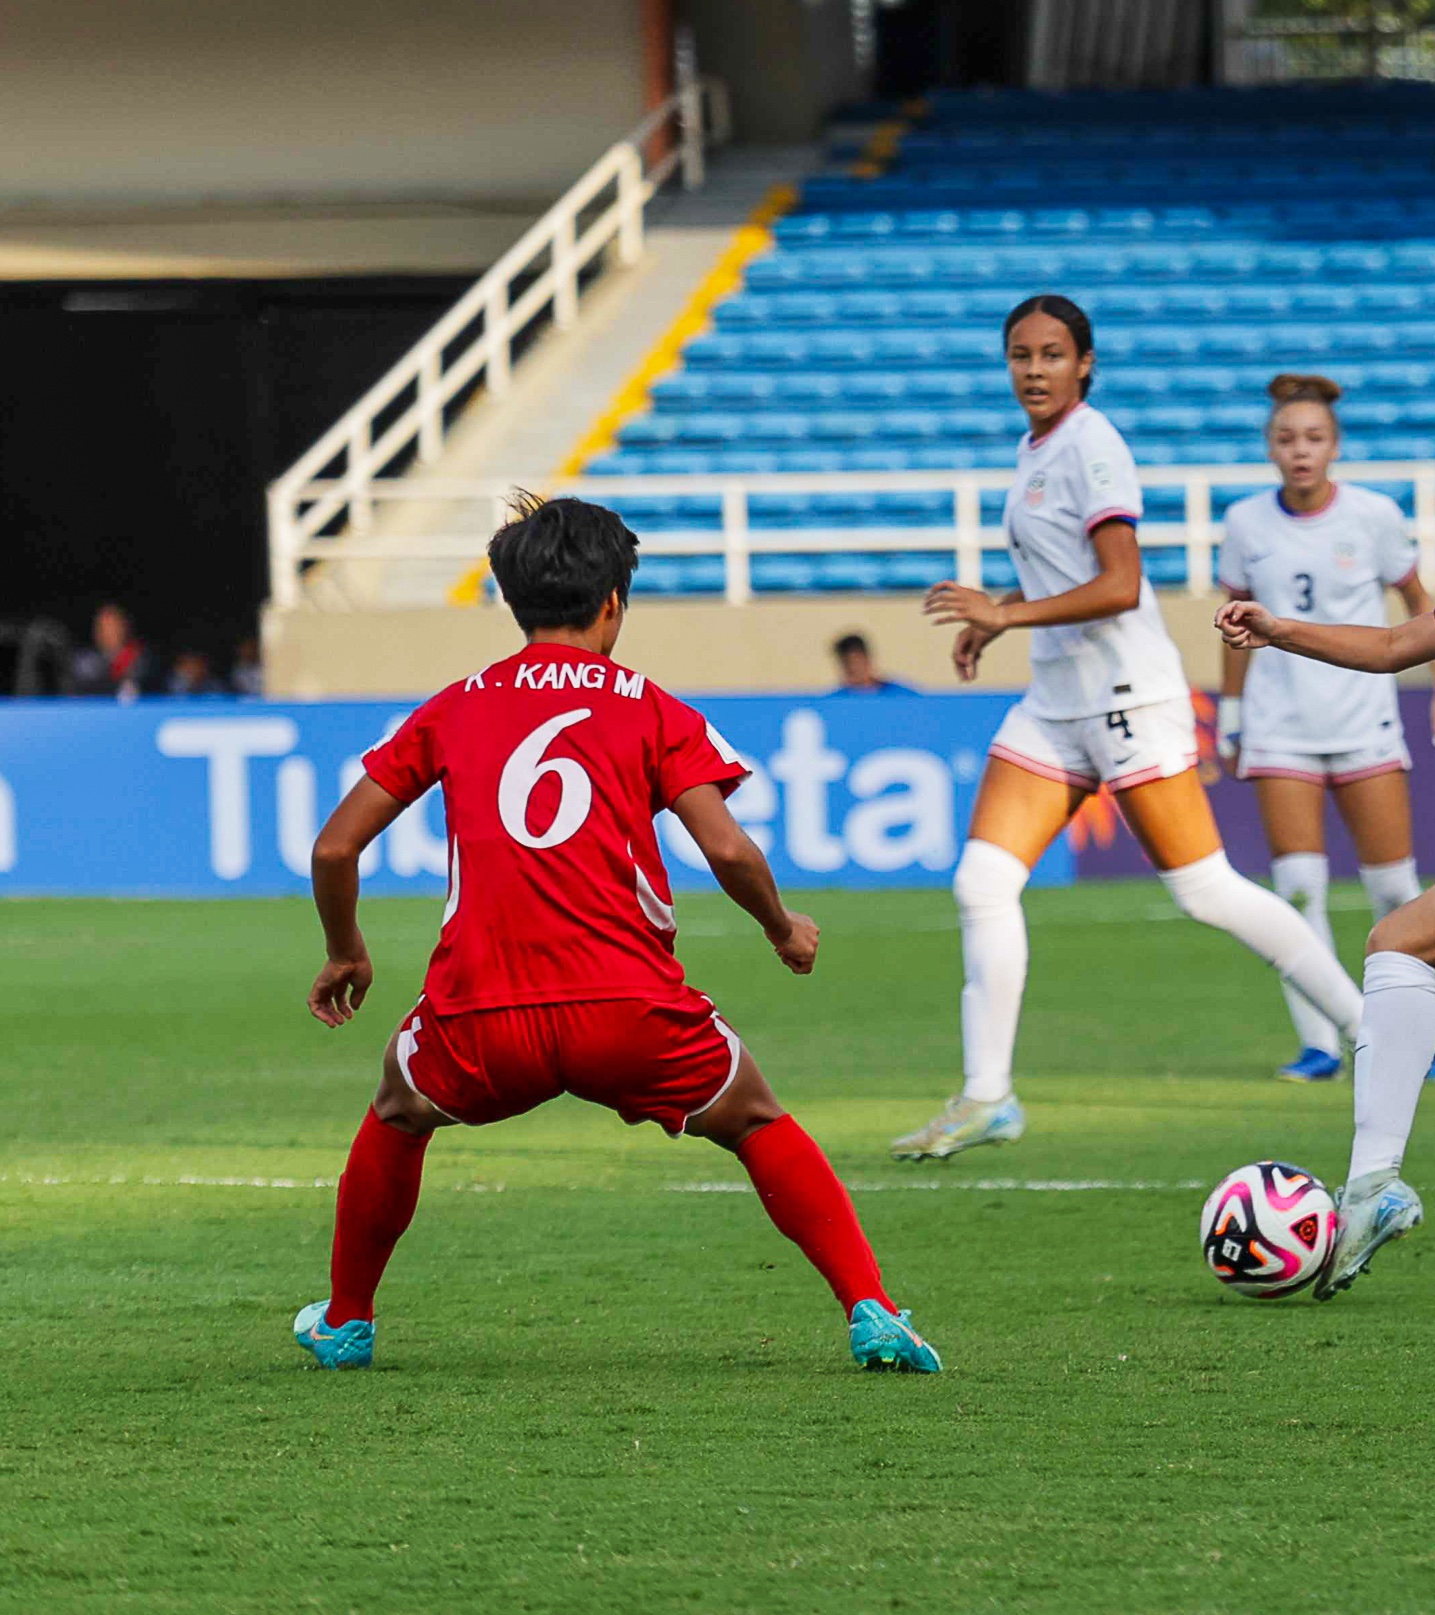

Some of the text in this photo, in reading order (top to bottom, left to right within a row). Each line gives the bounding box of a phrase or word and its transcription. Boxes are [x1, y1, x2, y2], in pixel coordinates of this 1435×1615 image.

[1292, 573, 1314, 612] 3
[514, 662, 606, 690] KANG
[613, 669, 646, 700] MI
[1106, 709, 1133, 739] 4
[498, 708, 592, 850] 6
